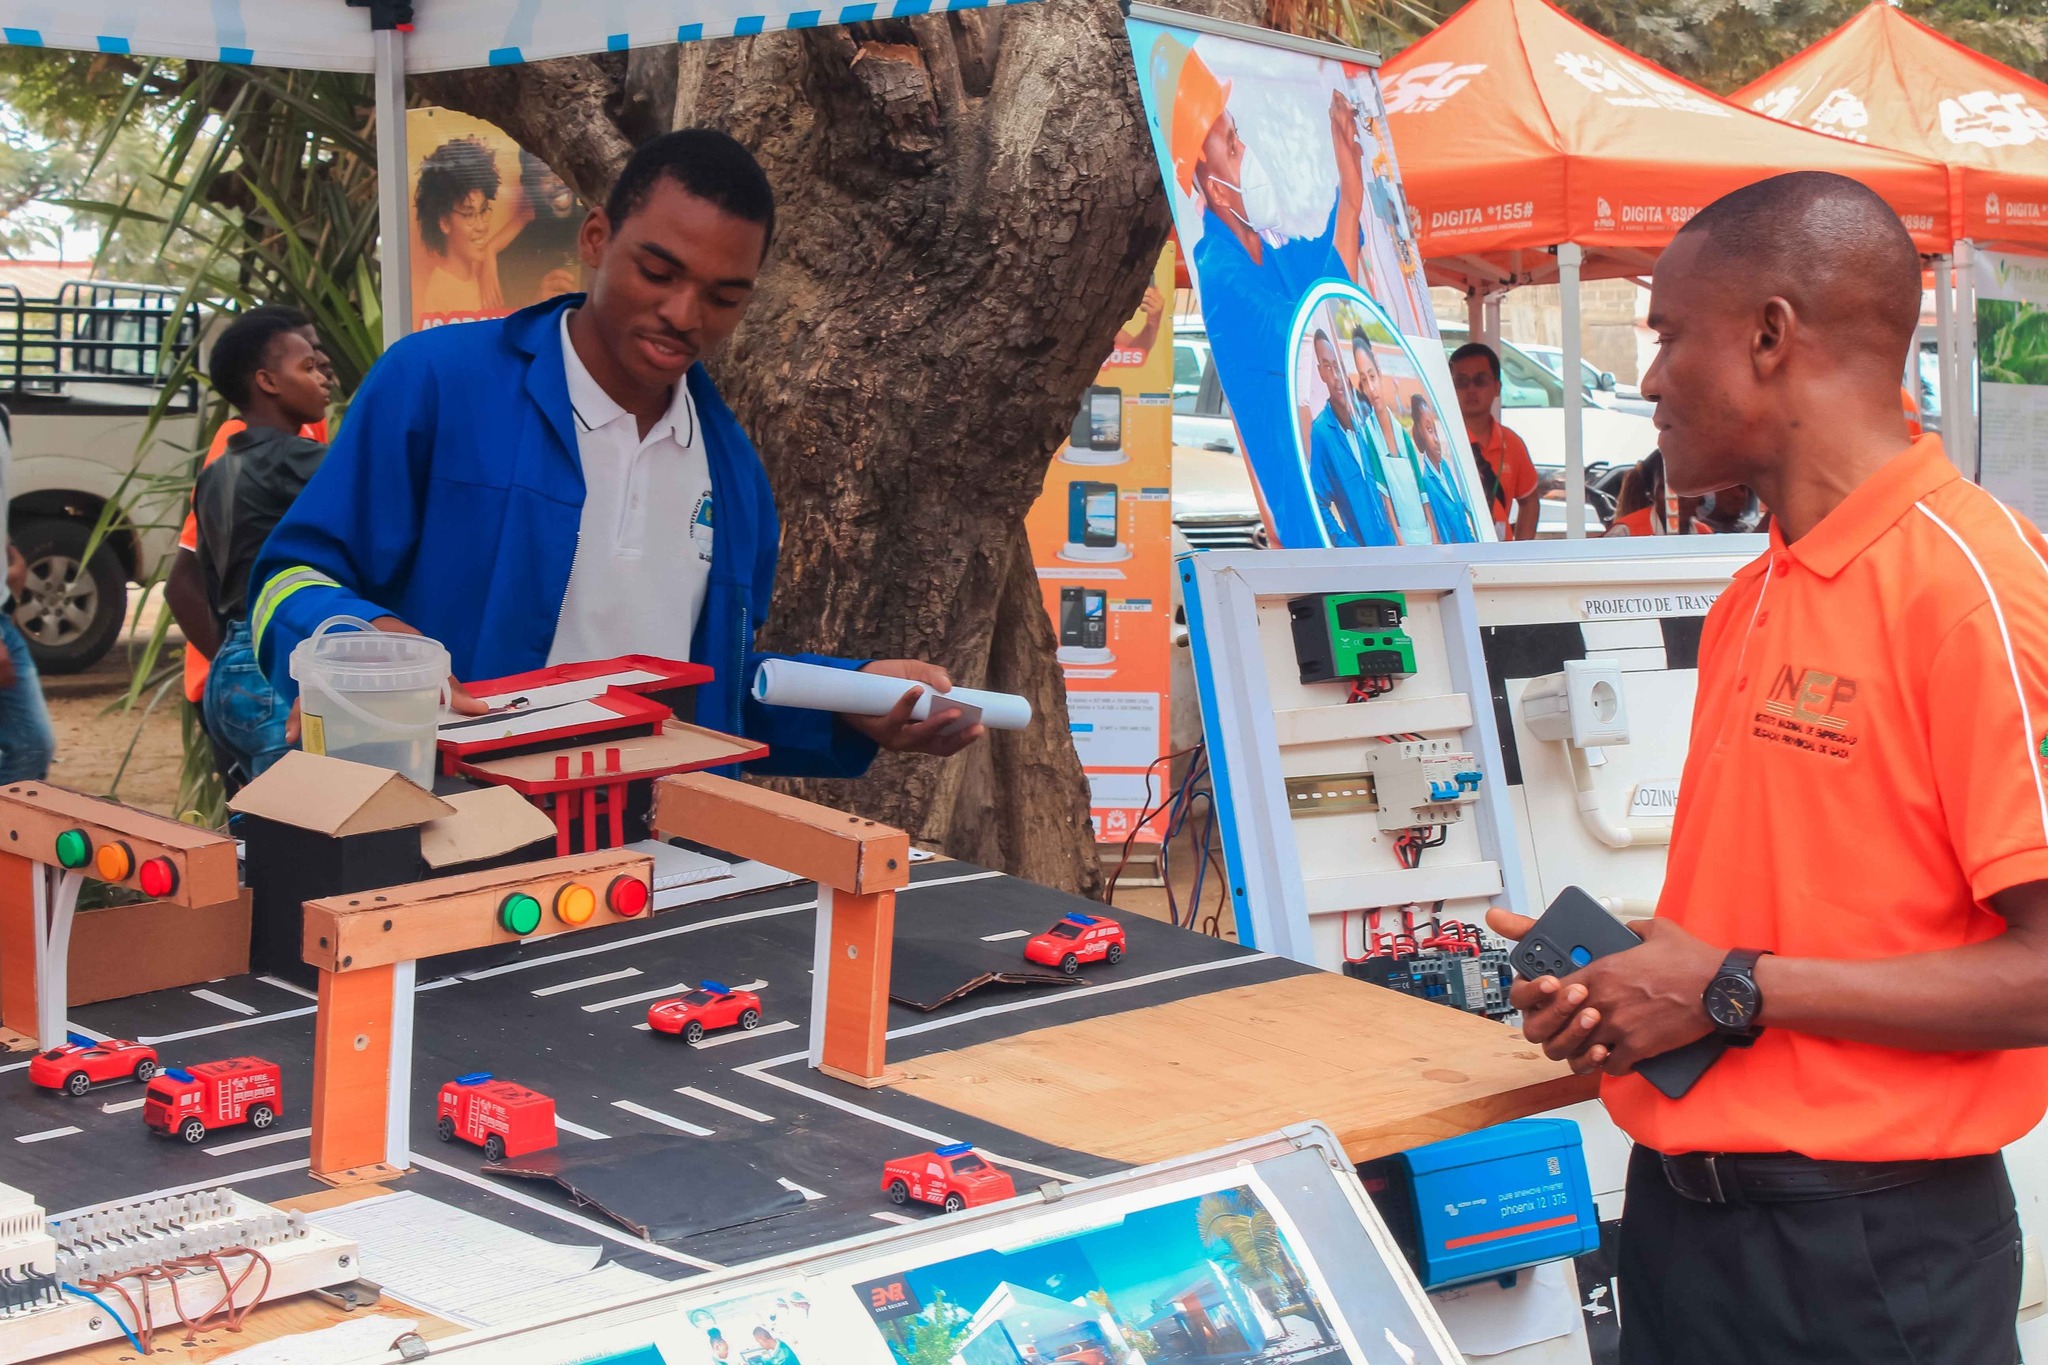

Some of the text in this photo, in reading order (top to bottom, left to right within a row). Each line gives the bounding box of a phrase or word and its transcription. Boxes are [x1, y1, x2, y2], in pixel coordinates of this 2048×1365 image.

[1431, 207, 1483, 229] DIGITA
[1621, 205, 1704, 223] DIGITA 898
[2005, 202, 2040, 218] DIGITA
[1102, 347, 1143, 367] ÕES
[1585, 594, 1720, 615] PROJECTO DE TRANS
[1767, 664, 1857, 723] INEP
[249, 1073, 268, 1083] FIRE
[492, 1103, 506, 1114] FIRE
[1498, 1192, 1514, 1202] pure
[1501, 1192, 1568, 1218] phoenix 12 375
